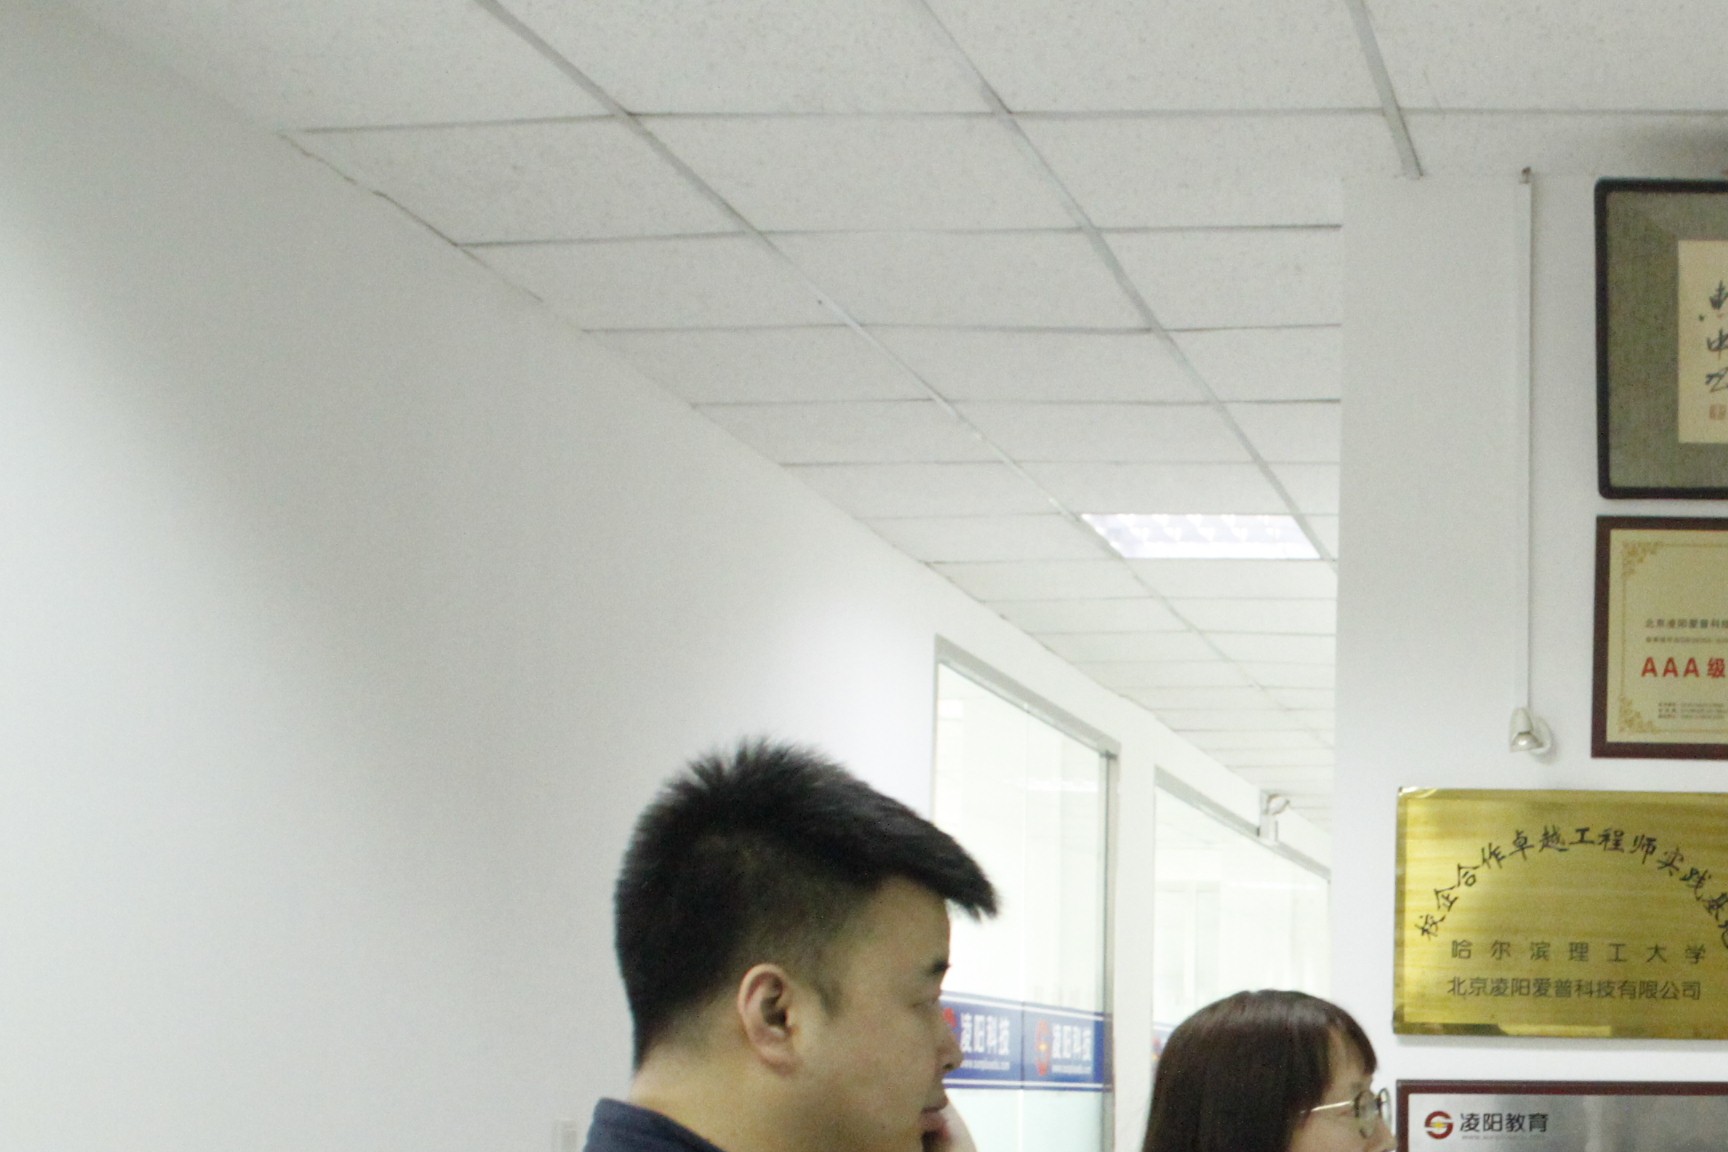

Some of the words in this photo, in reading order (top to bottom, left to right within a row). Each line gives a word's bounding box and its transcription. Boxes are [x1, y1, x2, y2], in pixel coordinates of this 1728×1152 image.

[1451, 939, 1707, 964] 哈尔滨理工大学
[1447, 976, 1702, 1001] 北京凌阳爱普科技有限公司
[1460, 1112, 1549, 1133] 凌阳教育
